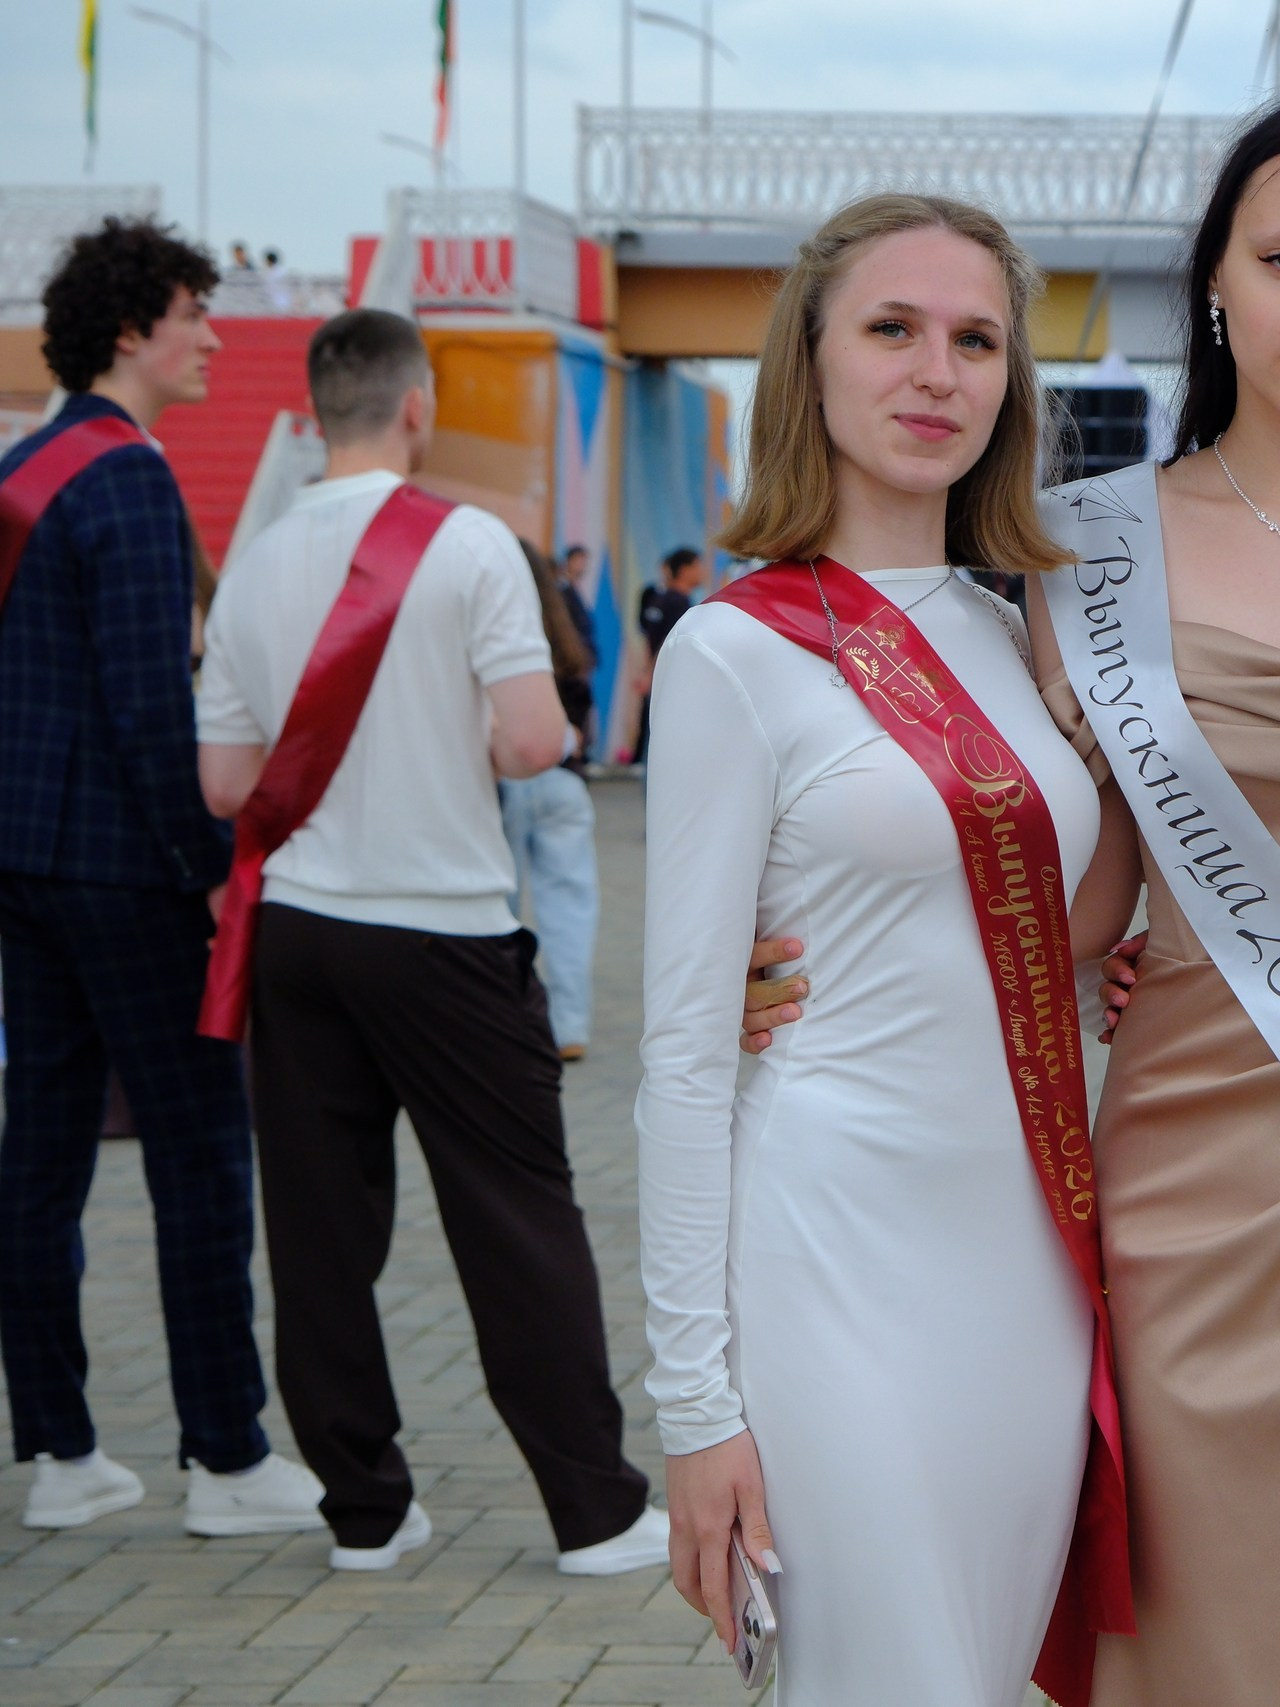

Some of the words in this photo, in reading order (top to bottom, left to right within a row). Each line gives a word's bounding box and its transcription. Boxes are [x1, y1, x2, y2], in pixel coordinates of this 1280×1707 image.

[1069, 535, 1269, 919] Выпускница
[953, 796, 977, 818] 11
[964, 825, 985, 846] А
[971, 851, 990, 893] класс
[943, 713, 1061, 1084] Выпускница
[1053, 1098, 1094, 1221] 2026
[990, 932, 1021, 997] МБОУ
[1060, 995, 1077, 1070] Карина
[1017, 1066, 1039, 1091] №
[1032, 1130, 1056, 1181] НМР
